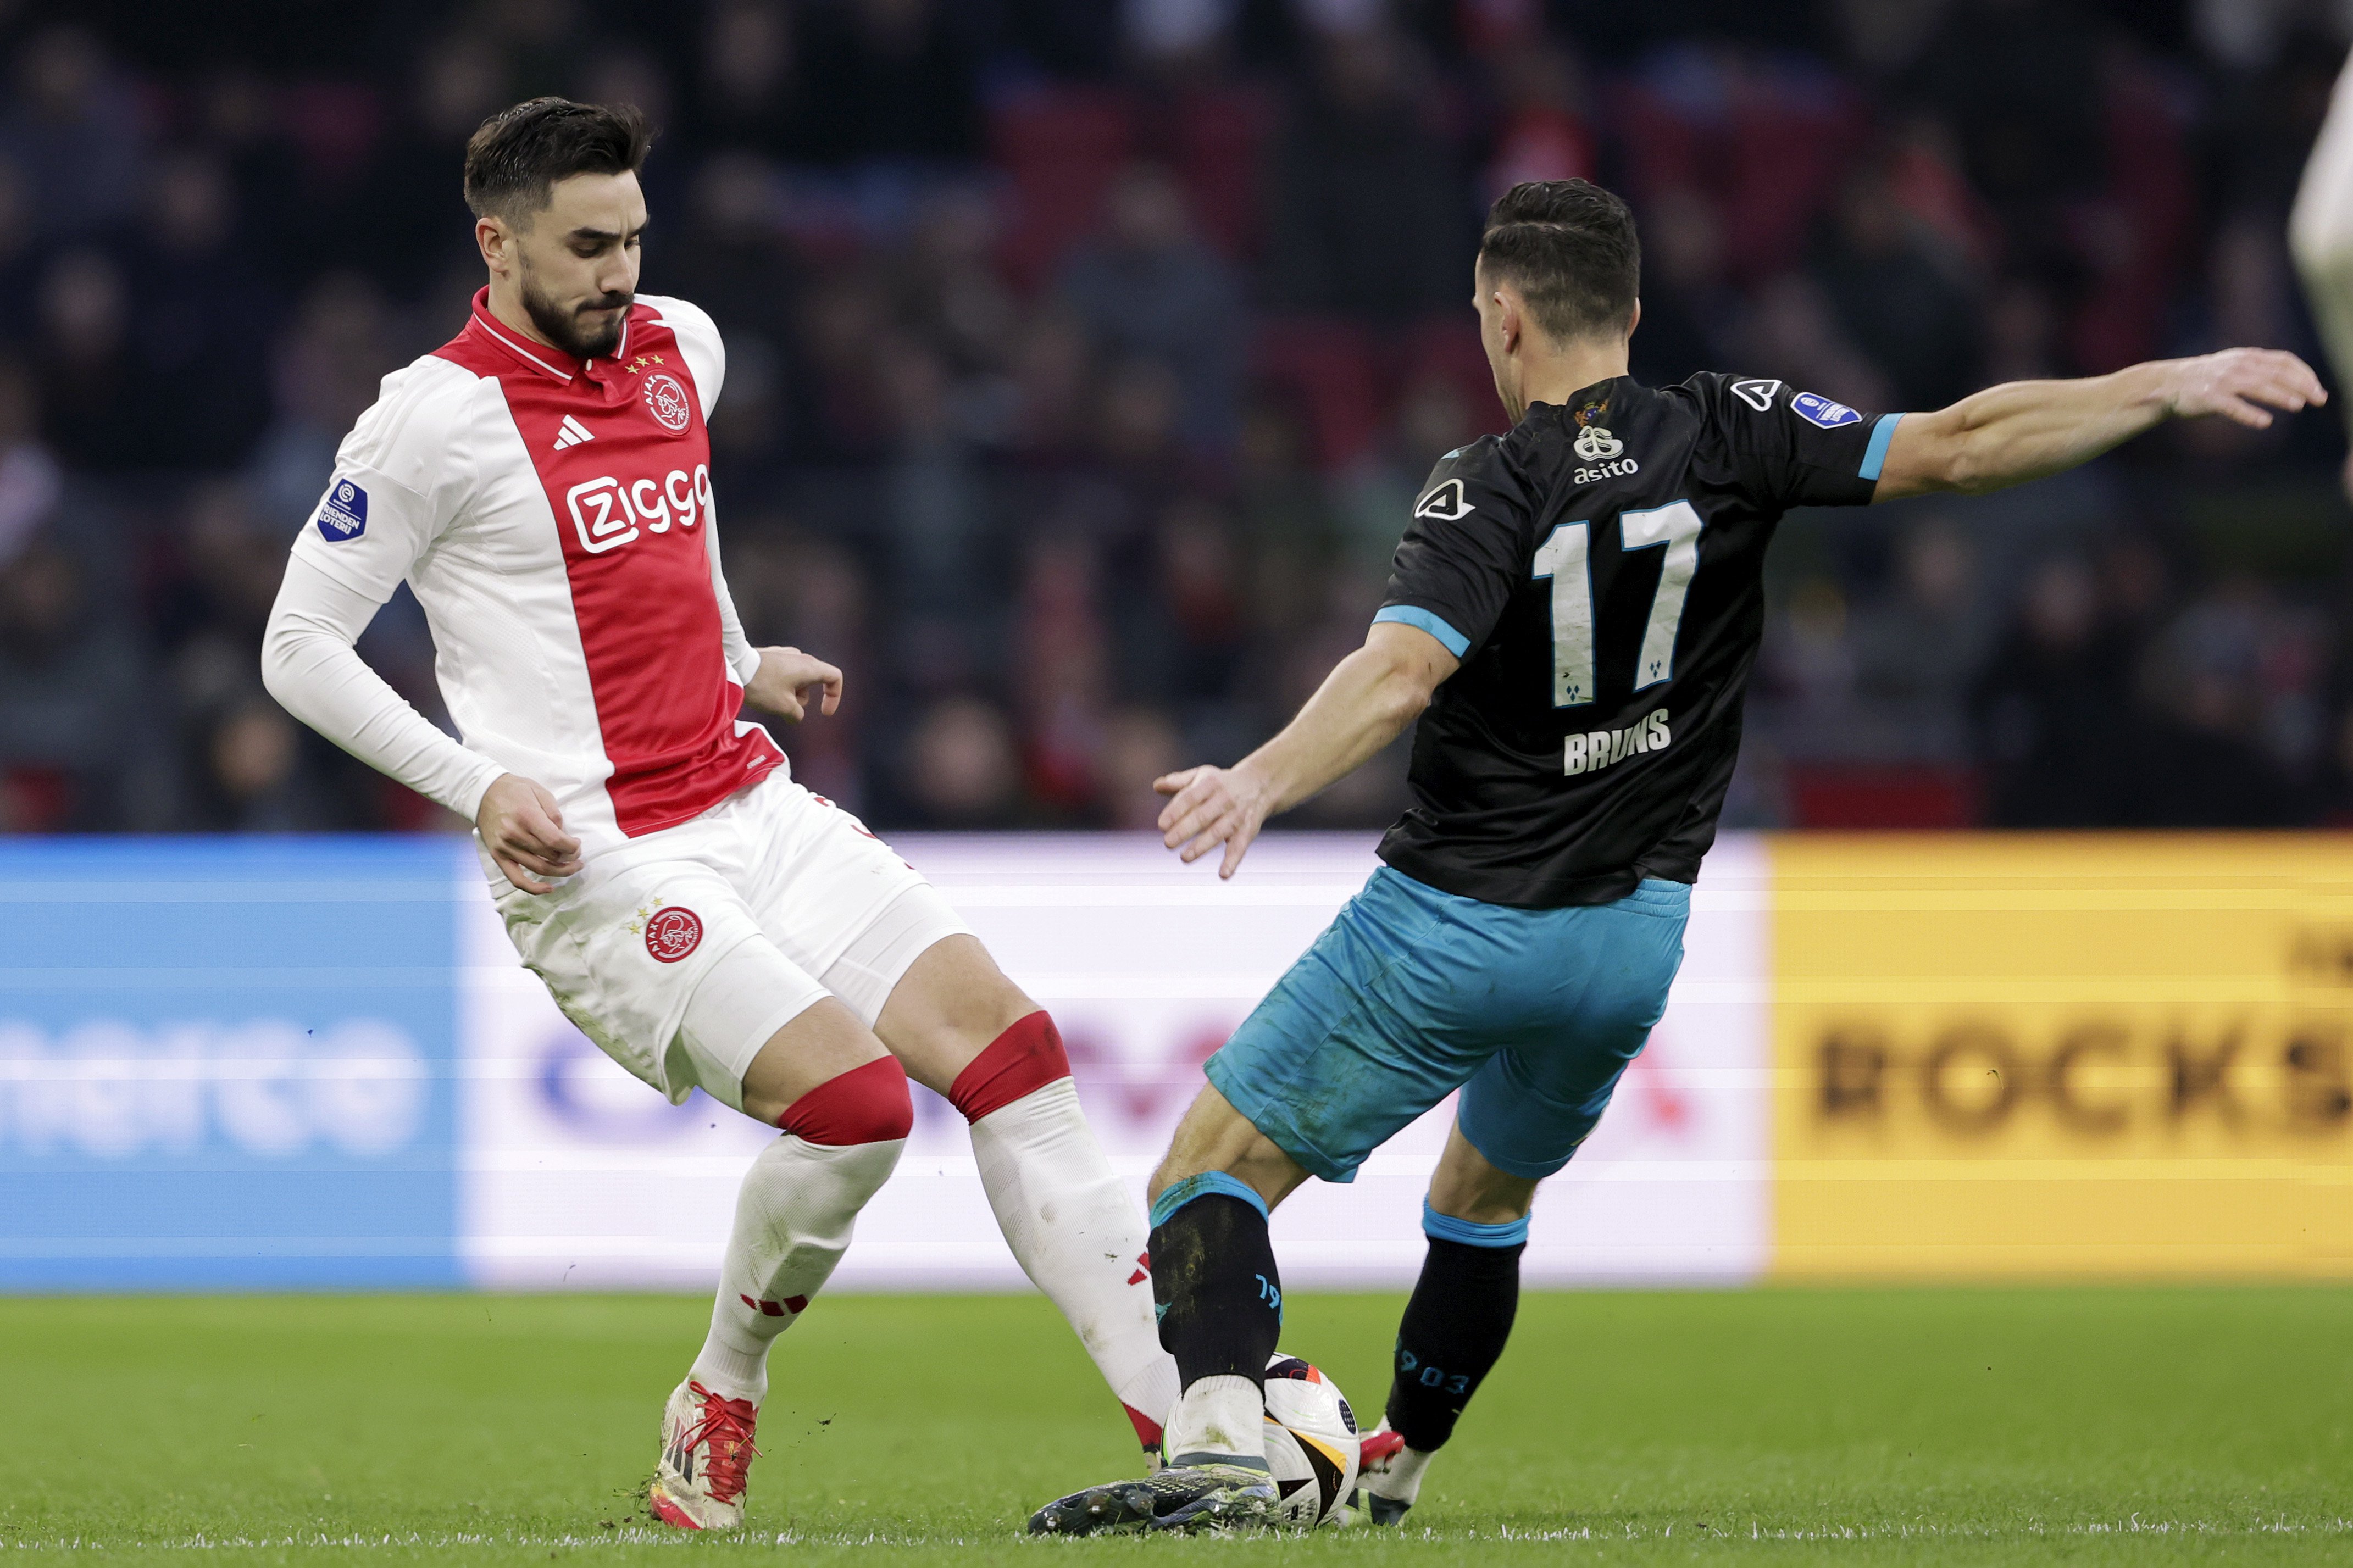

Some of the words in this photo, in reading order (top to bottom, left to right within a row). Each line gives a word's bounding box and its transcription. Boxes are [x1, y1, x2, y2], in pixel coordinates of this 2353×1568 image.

[644, 375, 657, 405] AJAX
[1574, 458, 1639, 485] asito
[319, 511, 352, 535] LOTERIJ
[323, 504, 360, 530] RIENDEN
[1531, 498, 1703, 710] 17
[1564, 708, 1671, 776] BRUNS
[647, 923, 661, 952] AJAX
